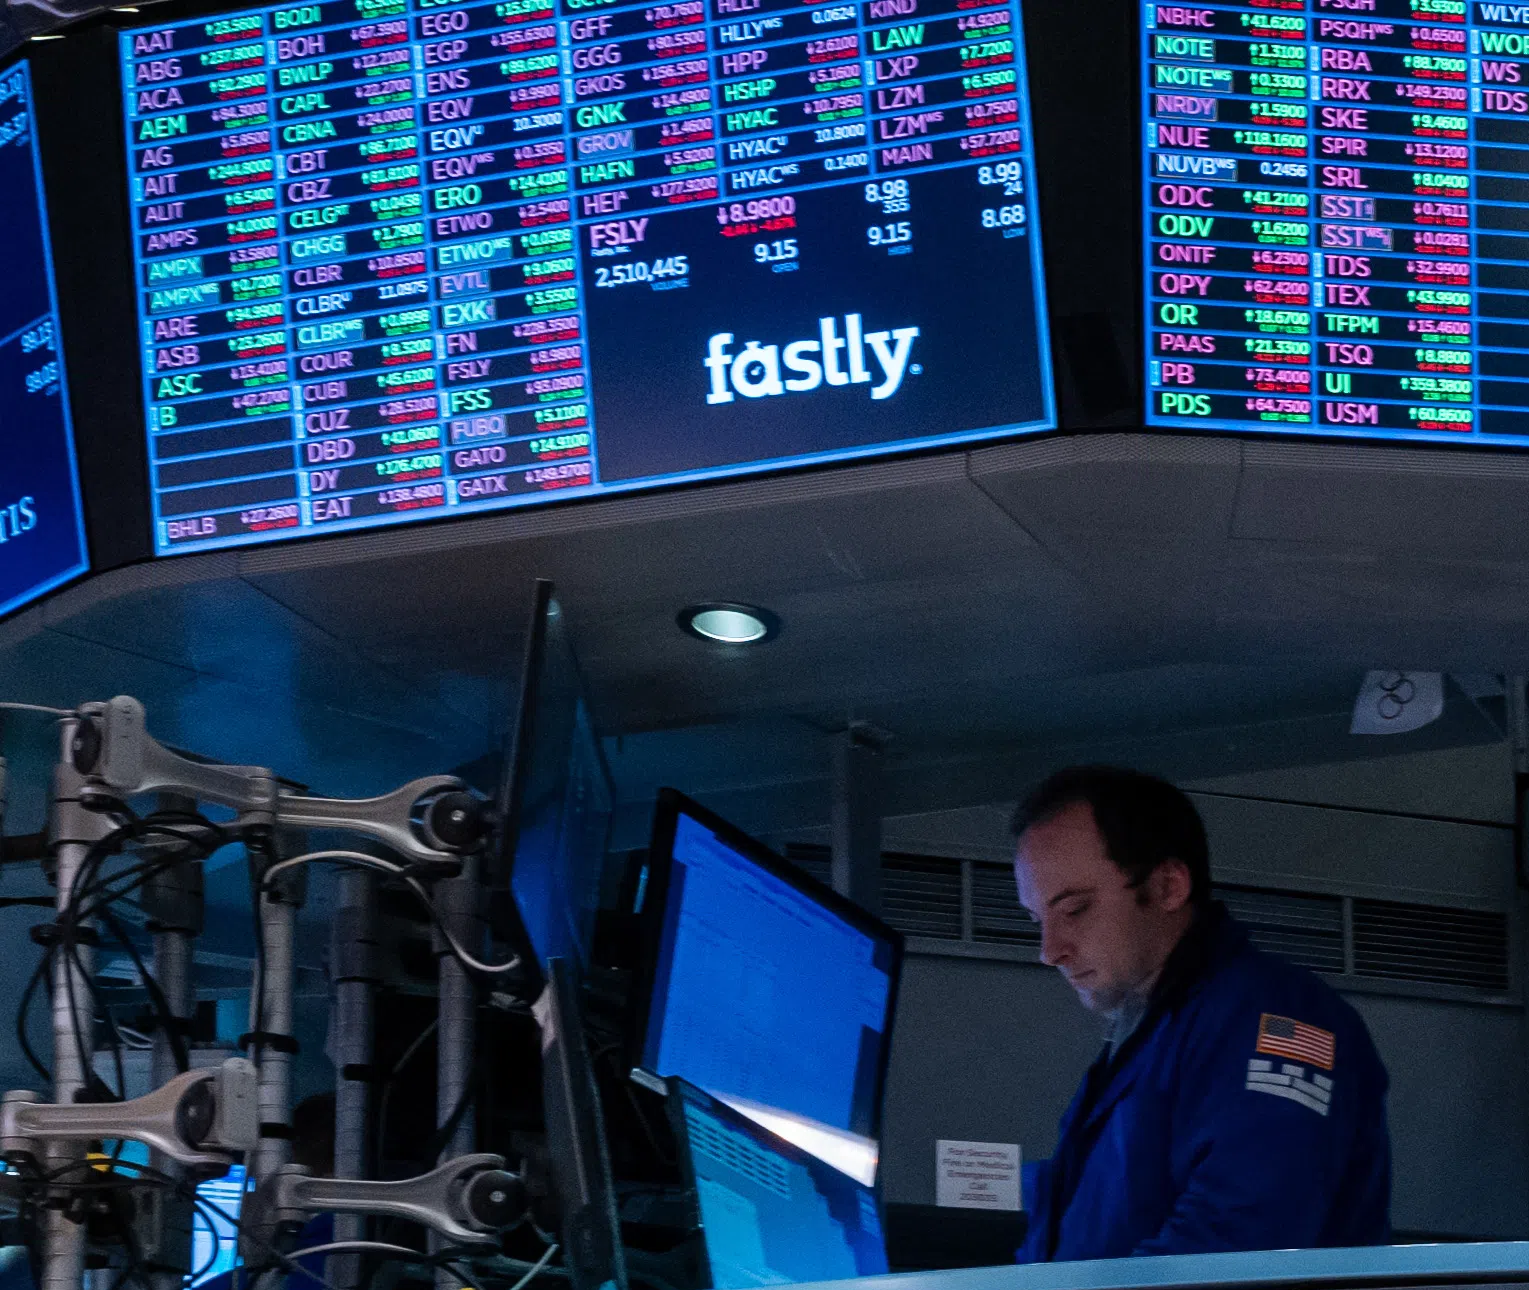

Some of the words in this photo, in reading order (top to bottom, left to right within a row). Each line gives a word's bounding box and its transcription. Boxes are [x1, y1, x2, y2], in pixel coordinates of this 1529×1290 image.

[275, 6, 321, 28] BODI
[422, 11, 469, 36] EGO
[570, 16, 613, 39] GFF
[1157, 7, 1215, 27] NBHC
[135, 30, 176, 54] AAT
[278, 35, 325, 59] BOH
[873, 25, 925, 51] LAW
[1156, 37, 1214, 57] NOTE
[425, 40, 468, 64] EGP
[573, 44, 621, 68] GGG
[723, 50, 768, 74] HPP
[1322, 49, 1372, 71] RBA
[136, 59, 182, 82] ABG
[279, 63, 333, 86] BWLP
[876, 56, 919, 80] LXP
[1482, 61, 1521, 82] WS
[427, 69, 470, 93] ENS
[575, 74, 626, 96] GKOS
[725, 79, 776, 102] HSHP
[1322, 78, 1371, 100] RRX
[138, 87, 184, 111] ACA
[878, 85, 925, 110] LZM
[1157, 97, 1212, 115] NRDY
[1483, 91, 1528, 112] TDS
[428, 98, 473, 122] EQV
[576, 101, 627, 127] GNK
[727, 108, 778, 131] HYAC
[1322, 108, 1369, 130] SKE
[139, 115, 187, 140] AEM
[283, 121, 337, 142] CBNA
[1159, 125, 1210, 148] NUE
[142, 147, 174, 168] AG
[882, 143, 933, 166] MAIN
[1322, 137, 1367, 156] SPIR
[287, 150, 328, 173] CBT
[581, 160, 634, 183] HAFN
[1323, 166, 1368, 189] SRL
[288, 179, 333, 202] CBZ
[435, 185, 482, 209] ERO
[1159, 185, 1214, 207] ODC
[589, 218, 648, 247] FSLY
[730, 196, 796, 222] 8.9800
[865, 180, 909, 203] 8.98
[979, 162, 1021, 185] 8.99
[436, 212, 493, 235] ETWO
[1159, 215, 1214, 237] ODV
[147, 230, 198, 251] AMPS
[292, 234, 345, 257] CHGG
[595, 256, 688, 288] 2,510,445
[754, 240, 797, 263] 9.15
[868, 222, 912, 246] 9.15
[982, 205, 1026, 228] 8.68
[1160, 244, 1216, 264] ONTF
[295, 265, 342, 286] CLBR
[1325, 255, 1371, 277] TDS
[441, 271, 487, 293] EVTL
[1160, 274, 1212, 295] OPY
[1326, 285, 1371, 307] TEX
[443, 300, 489, 324] EXK
[1160, 304, 1198, 325] OR
[155, 316, 199, 340] ARE
[1325, 314, 1379, 334] TFPM
[448, 332, 477, 354] FN
[1161, 334, 1216, 353] PAAS
[1326, 344, 1374, 365] TSQ
[156, 346, 200, 369] ASB
[300, 351, 353, 372] COUR
[704, 313, 920, 405] fastly
[448, 359, 491, 380] FSLY
[1162, 363, 1195, 384] PB
[158, 374, 203, 397] ASC
[304, 381, 347, 401] CUBI
[1326, 373, 1351, 393] UI
[452, 388, 492, 412] FSS
[1162, 393, 1211, 416] PDS
[160, 407, 177, 425] B
[306, 409, 351, 433] CUZ
[1326, 403, 1378, 424] USM
[452, 416, 500, 437] FUBO
[307, 439, 355, 462] DBD
[454, 446, 507, 467] GATO
[310, 469, 340, 491] DY
[457, 475, 508, 497] GATX
[312, 497, 352, 520] EAT
[168, 517, 217, 538] BHLB
